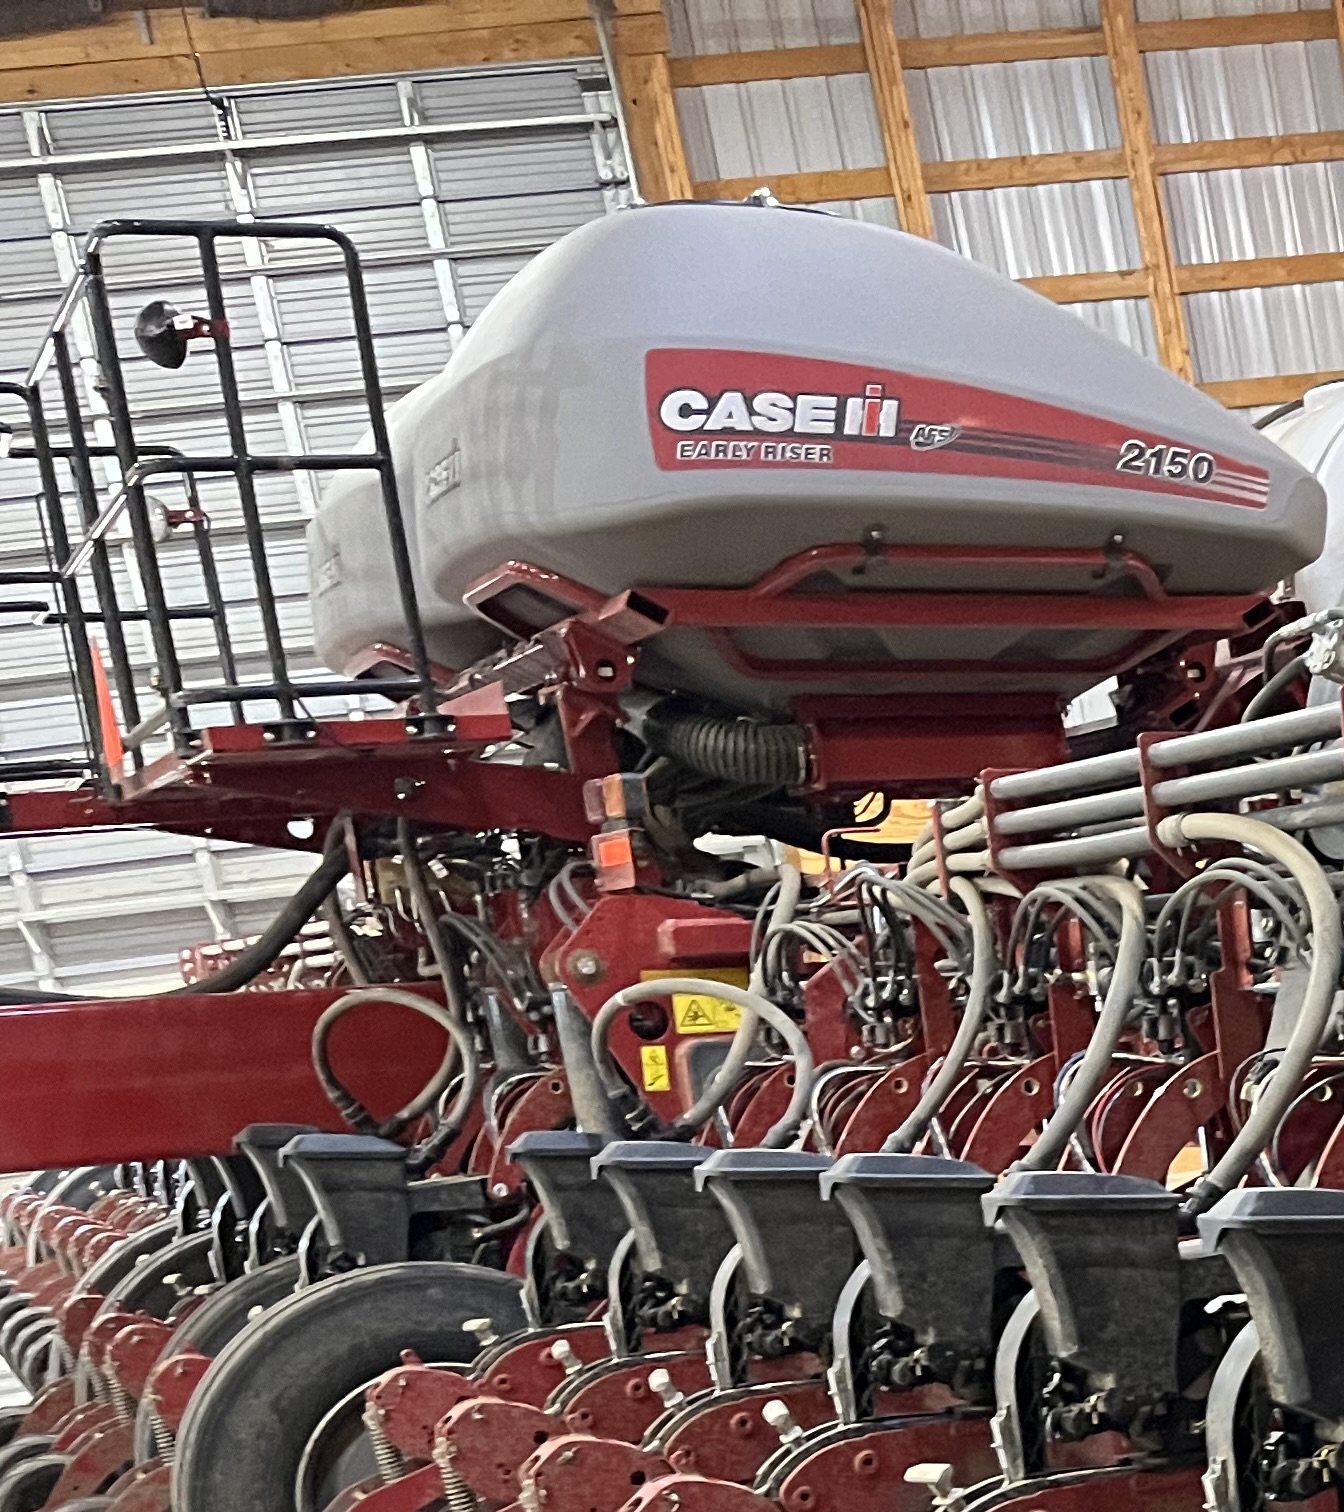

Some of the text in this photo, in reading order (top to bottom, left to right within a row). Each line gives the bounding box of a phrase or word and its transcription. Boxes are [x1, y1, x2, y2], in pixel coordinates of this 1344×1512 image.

[659, 388, 839, 434] CASE
[676, 440, 834, 464] EARLY RISER
[910, 424, 954, 450] AFS
[1115, 439, 1217, 486] 2150
